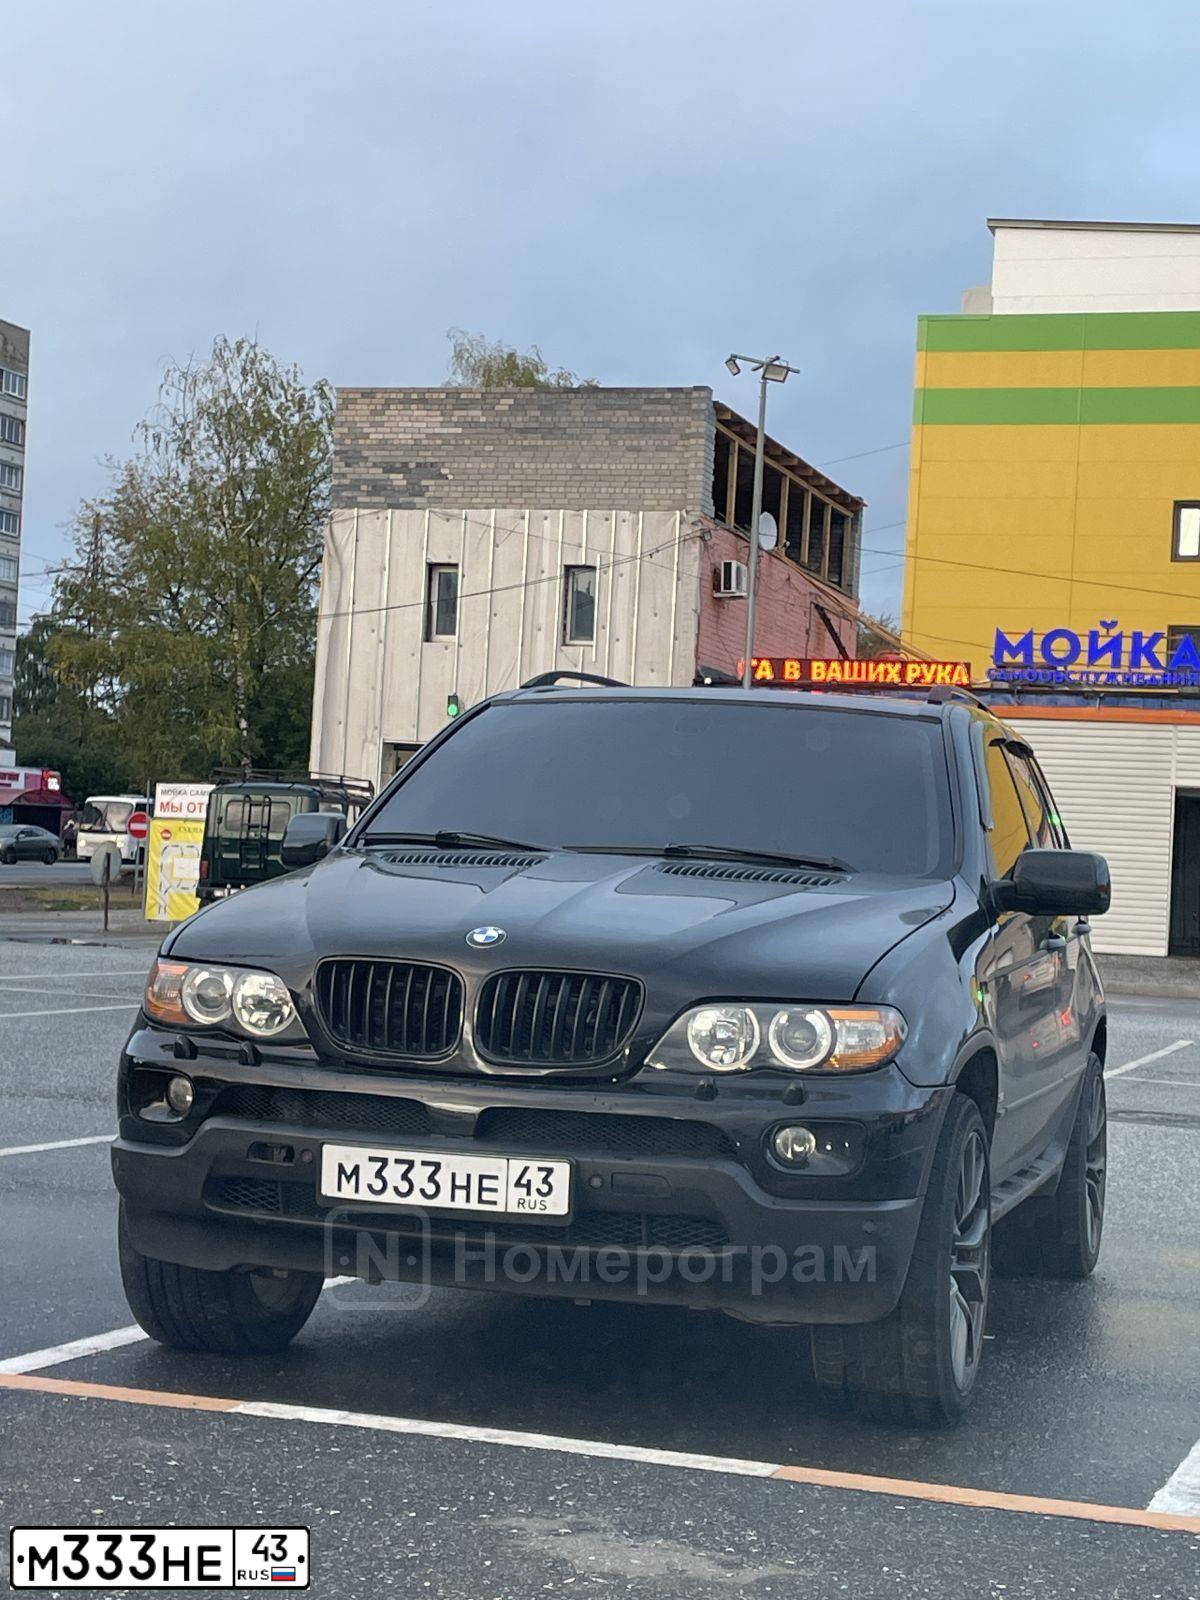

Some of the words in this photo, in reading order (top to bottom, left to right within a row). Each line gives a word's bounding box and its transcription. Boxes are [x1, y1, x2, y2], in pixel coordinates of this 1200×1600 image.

[993, 620, 1200, 671] МОЙКА
[784, 659, 801, 682] В
[811, 660, 901, 684] ВАШИХ
[906, 663, 970, 685] РУКА
[160, 801, 183, 813] МЫ
[336, 1156, 500, 1206] М333НЕ
[513, 1166, 555, 1198] 43
[517, 1198, 548, 1211] RUS
